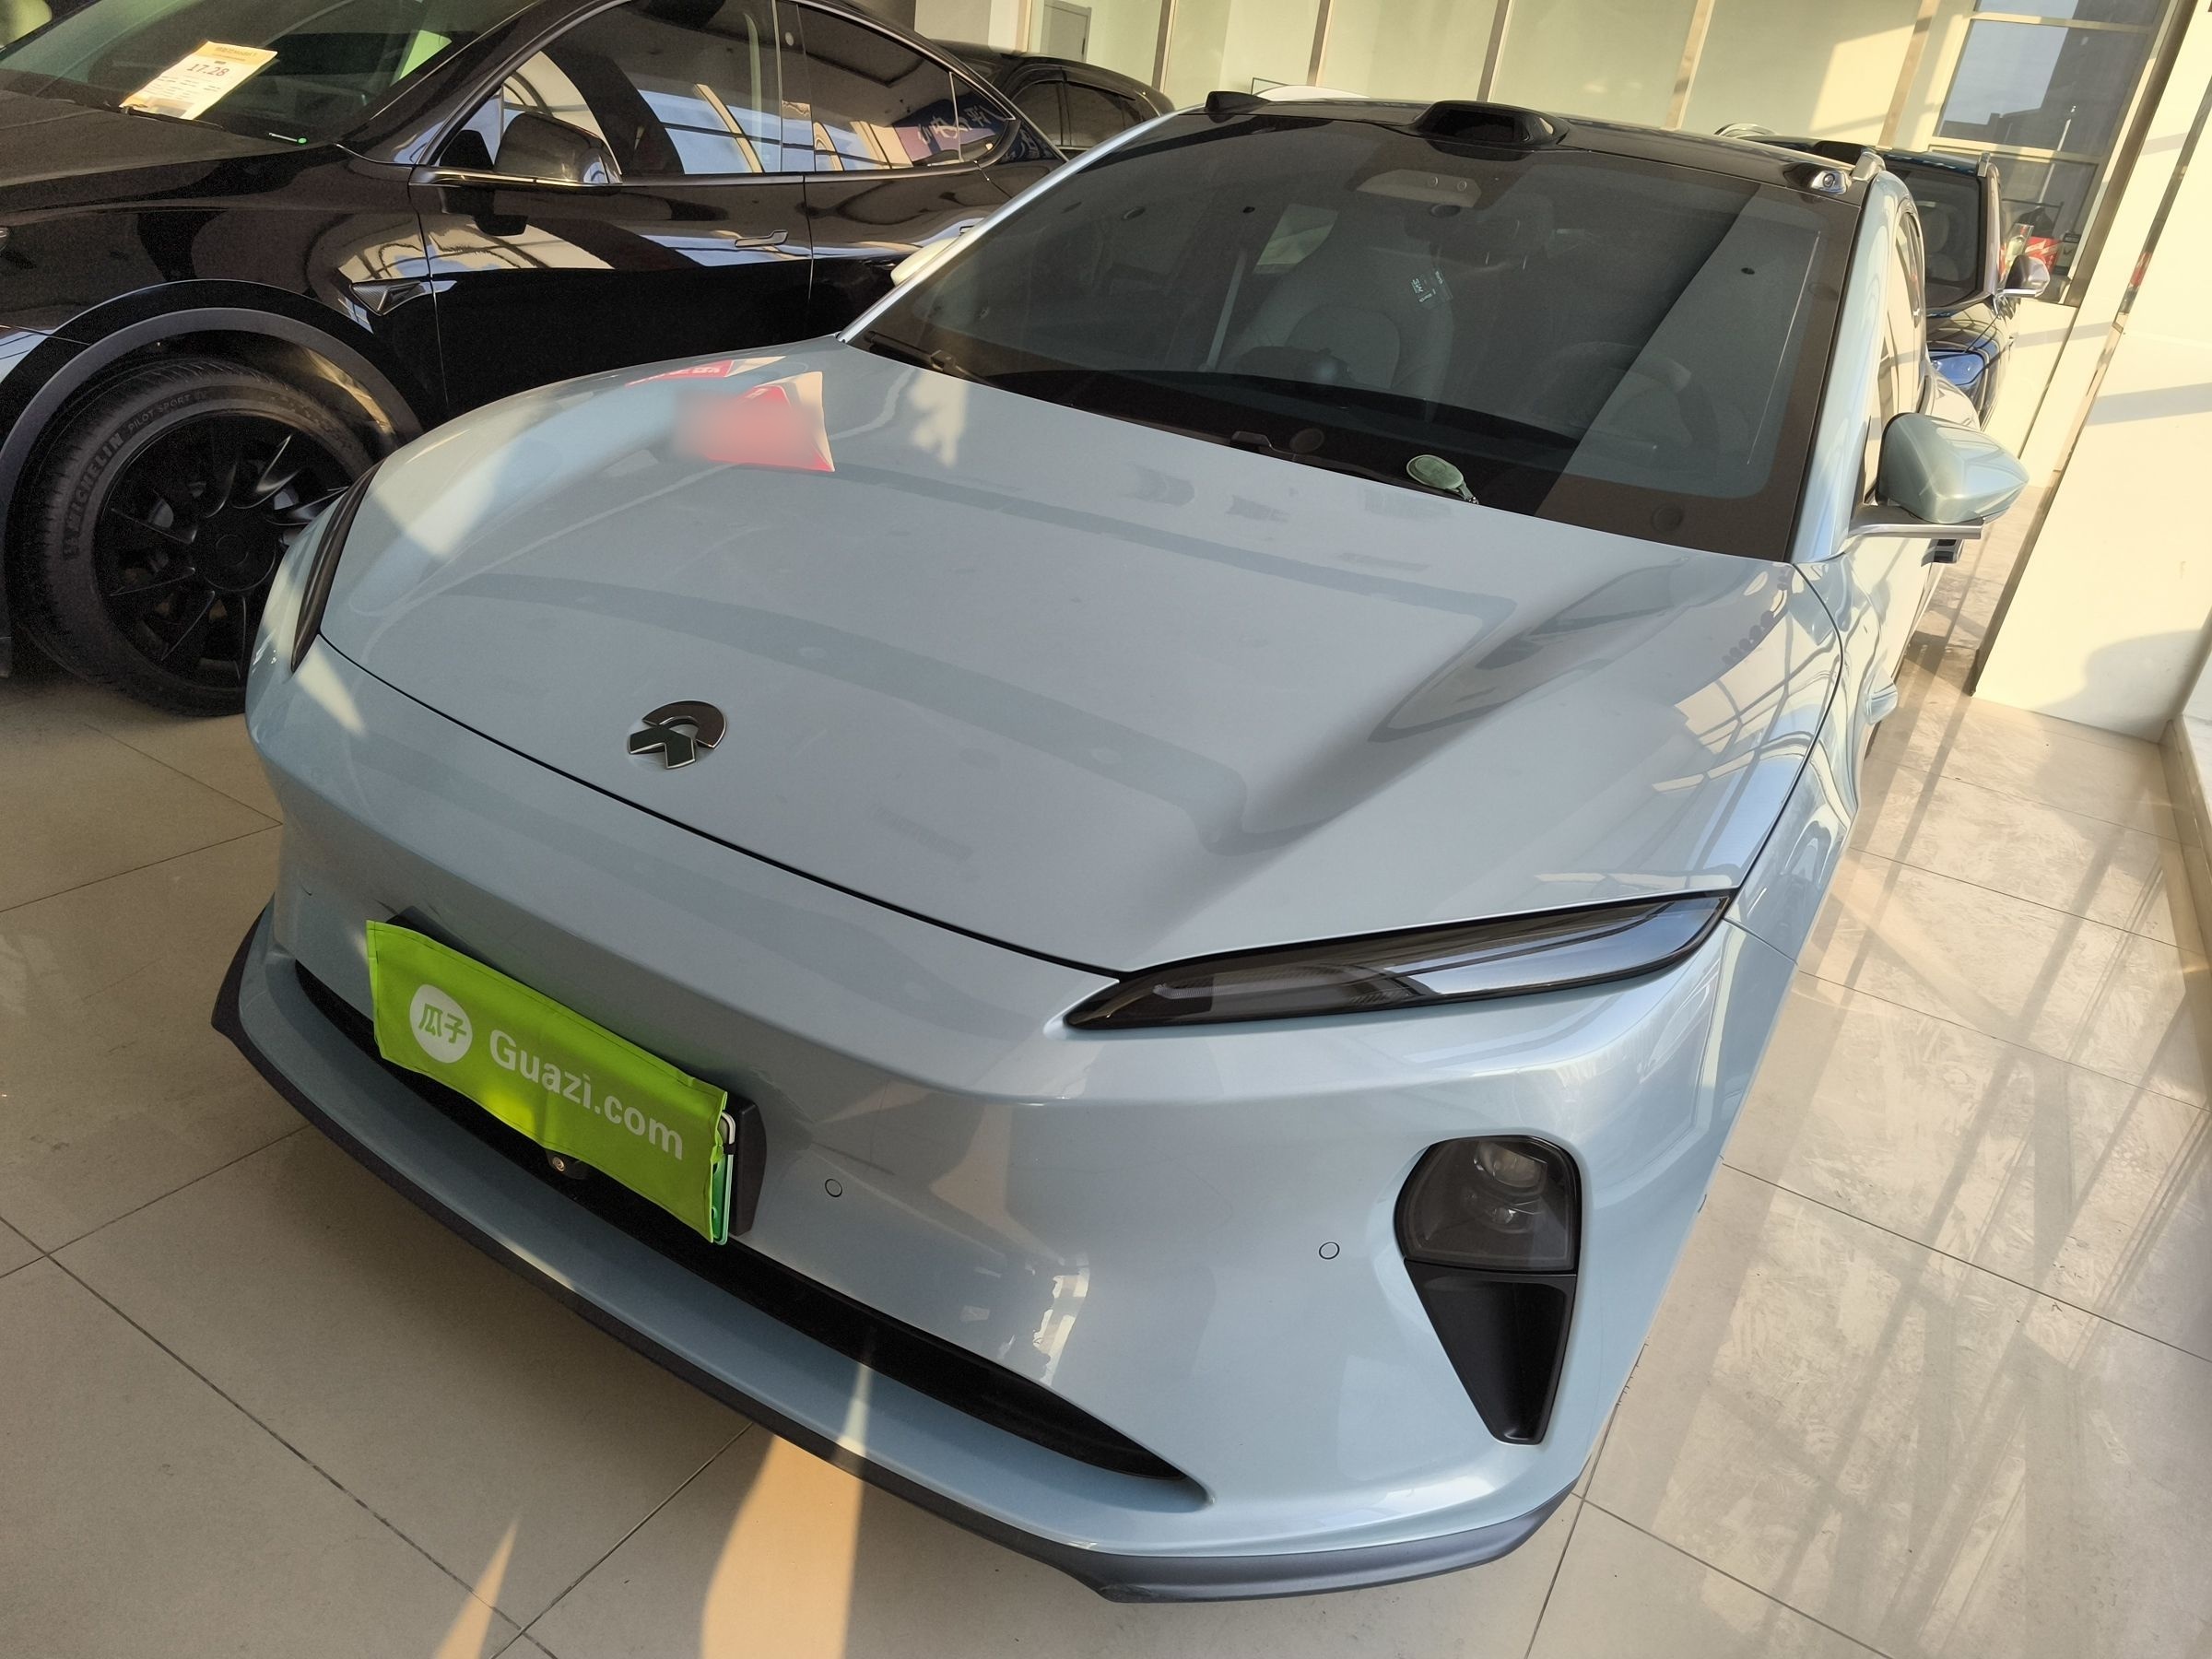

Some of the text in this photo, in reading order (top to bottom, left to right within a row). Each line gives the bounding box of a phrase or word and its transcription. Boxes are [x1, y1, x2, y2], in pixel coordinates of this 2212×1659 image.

[187, 64, 229, 76] 17.28
[66, 431, 124, 532] MICHELIN
[128, 409, 156, 434] PILOT
[158, 394, 191, 414] SPORT
[418, 1002, 467, 1044] 瓜子
[488, 1028, 684, 1160] Guazi.com
